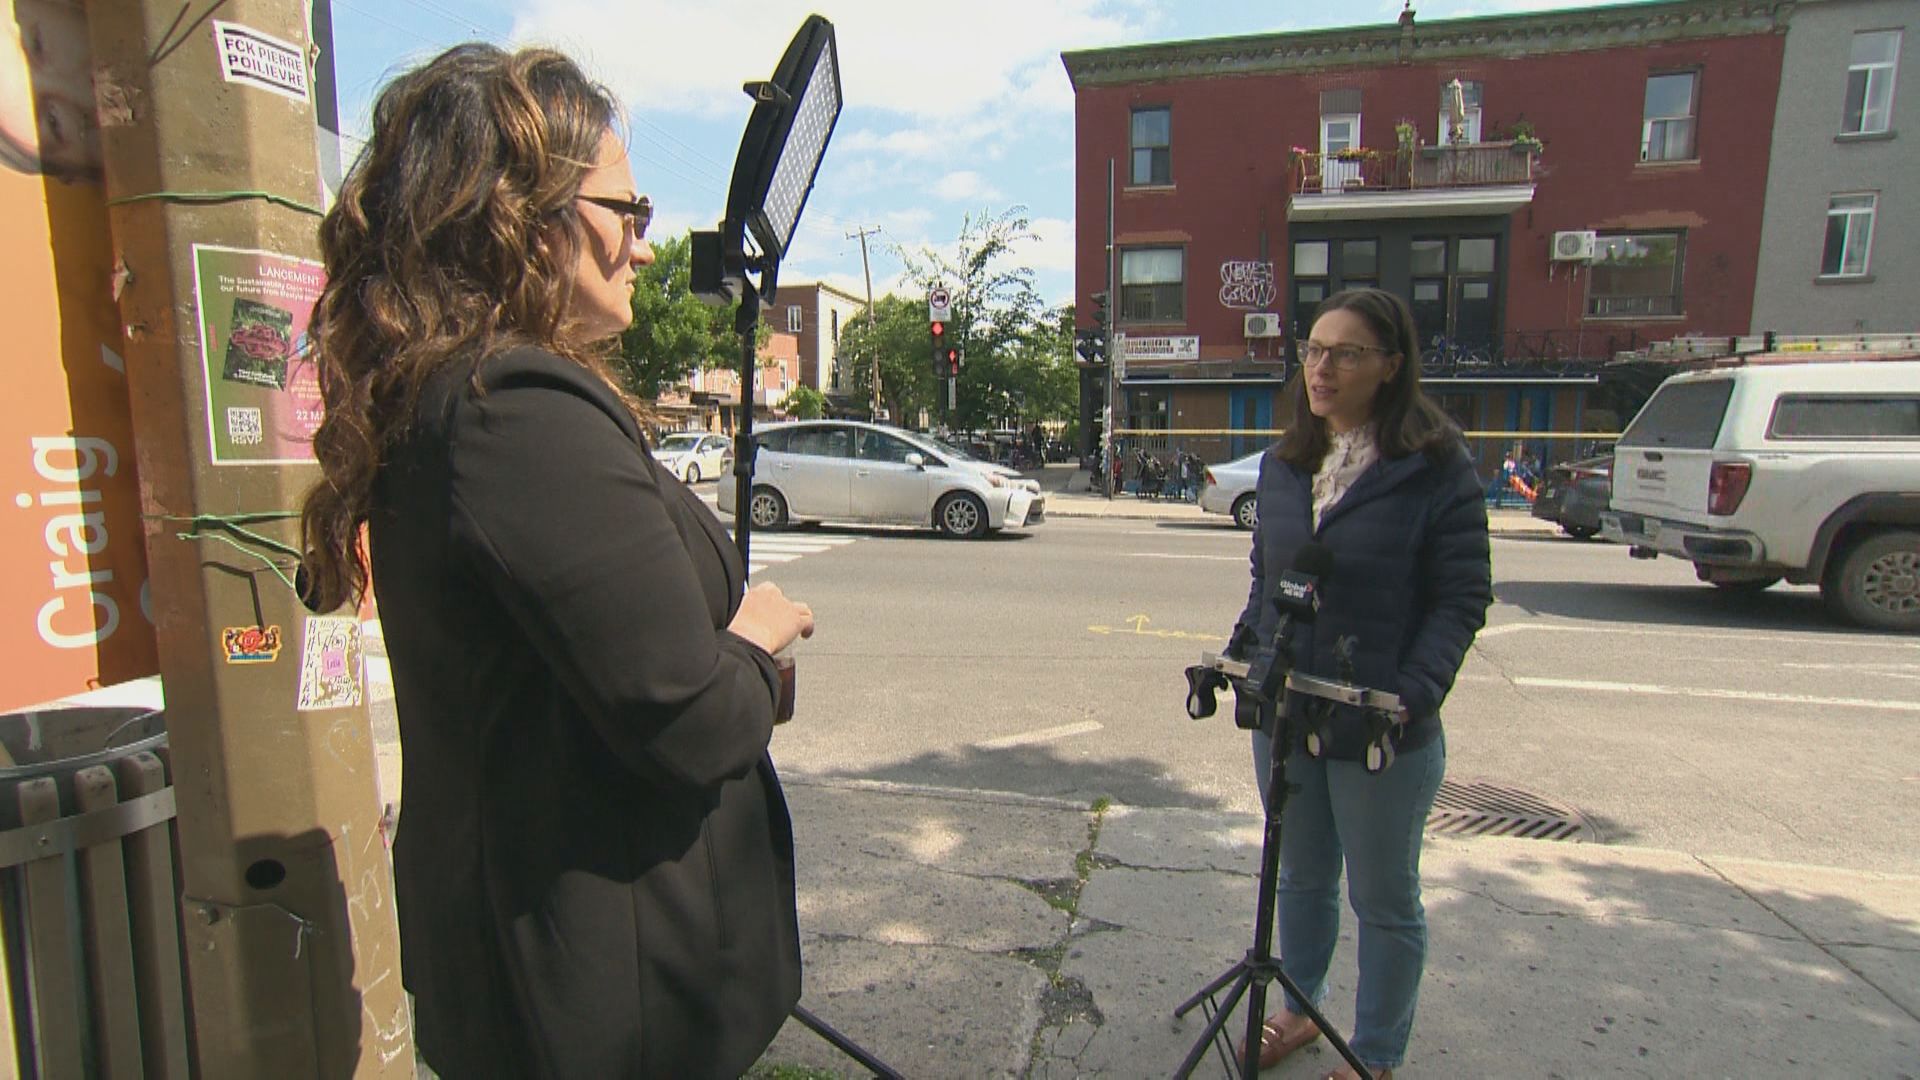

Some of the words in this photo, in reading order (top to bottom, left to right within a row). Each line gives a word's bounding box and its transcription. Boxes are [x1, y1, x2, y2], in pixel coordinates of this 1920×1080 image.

[225, 37, 255, 56] FCK
[258, 48, 302, 71] PIERRE
[228, 54, 303, 87] POILIEVRE
[218, 275, 234, 284] The
[259, 265, 320, 286] LANCEMENT
[296, 408, 307, 420] 22
[231, 434, 262, 445] RSVP
[16, 436, 120, 649] Craig
